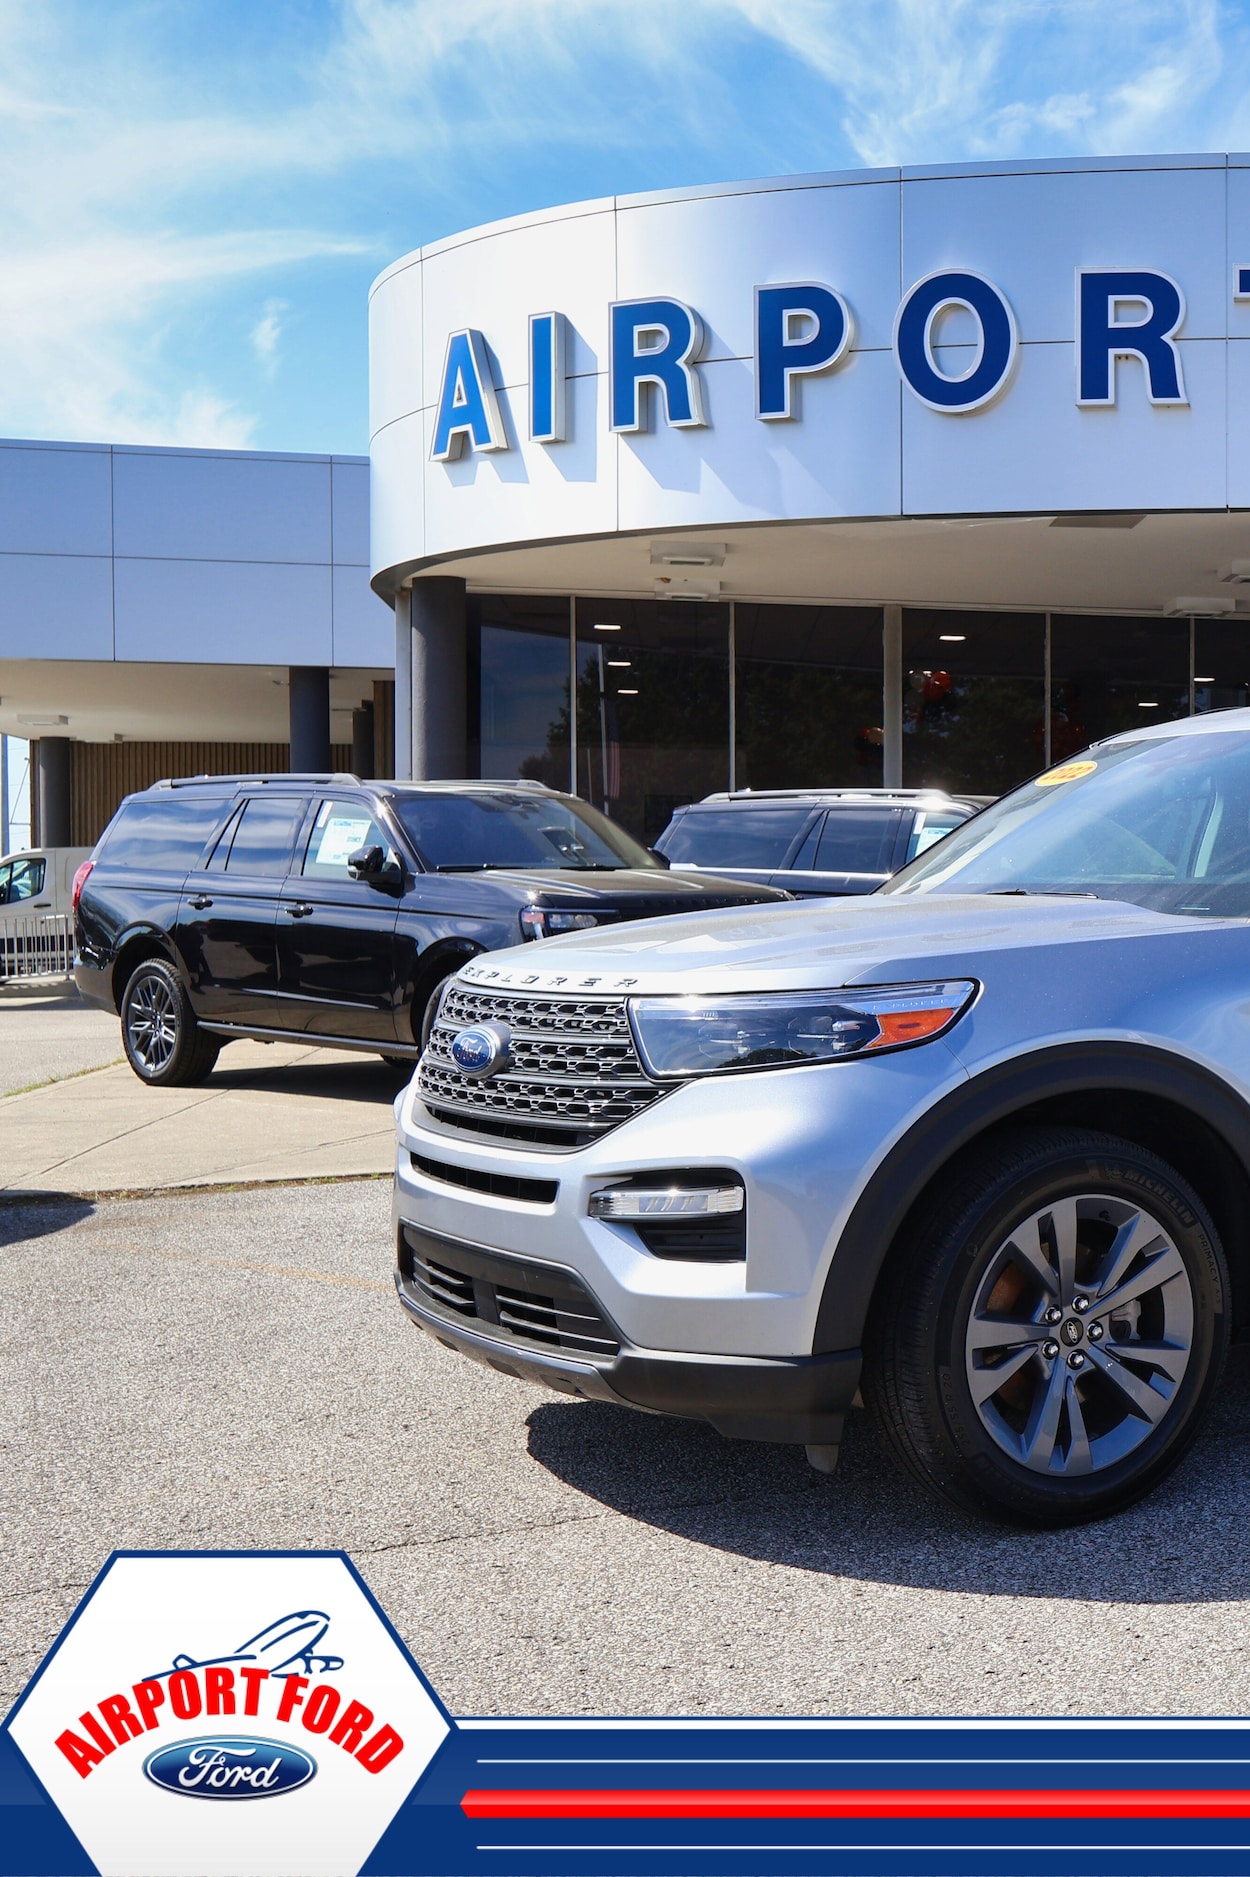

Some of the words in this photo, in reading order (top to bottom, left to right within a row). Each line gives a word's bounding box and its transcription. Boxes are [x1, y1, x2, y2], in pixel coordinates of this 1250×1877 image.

[462, 966, 638, 988] EXPLORER
[1125, 1169, 1195, 1225] MICHELIN
[1198, 1233, 1219, 1284] PRIMACY
